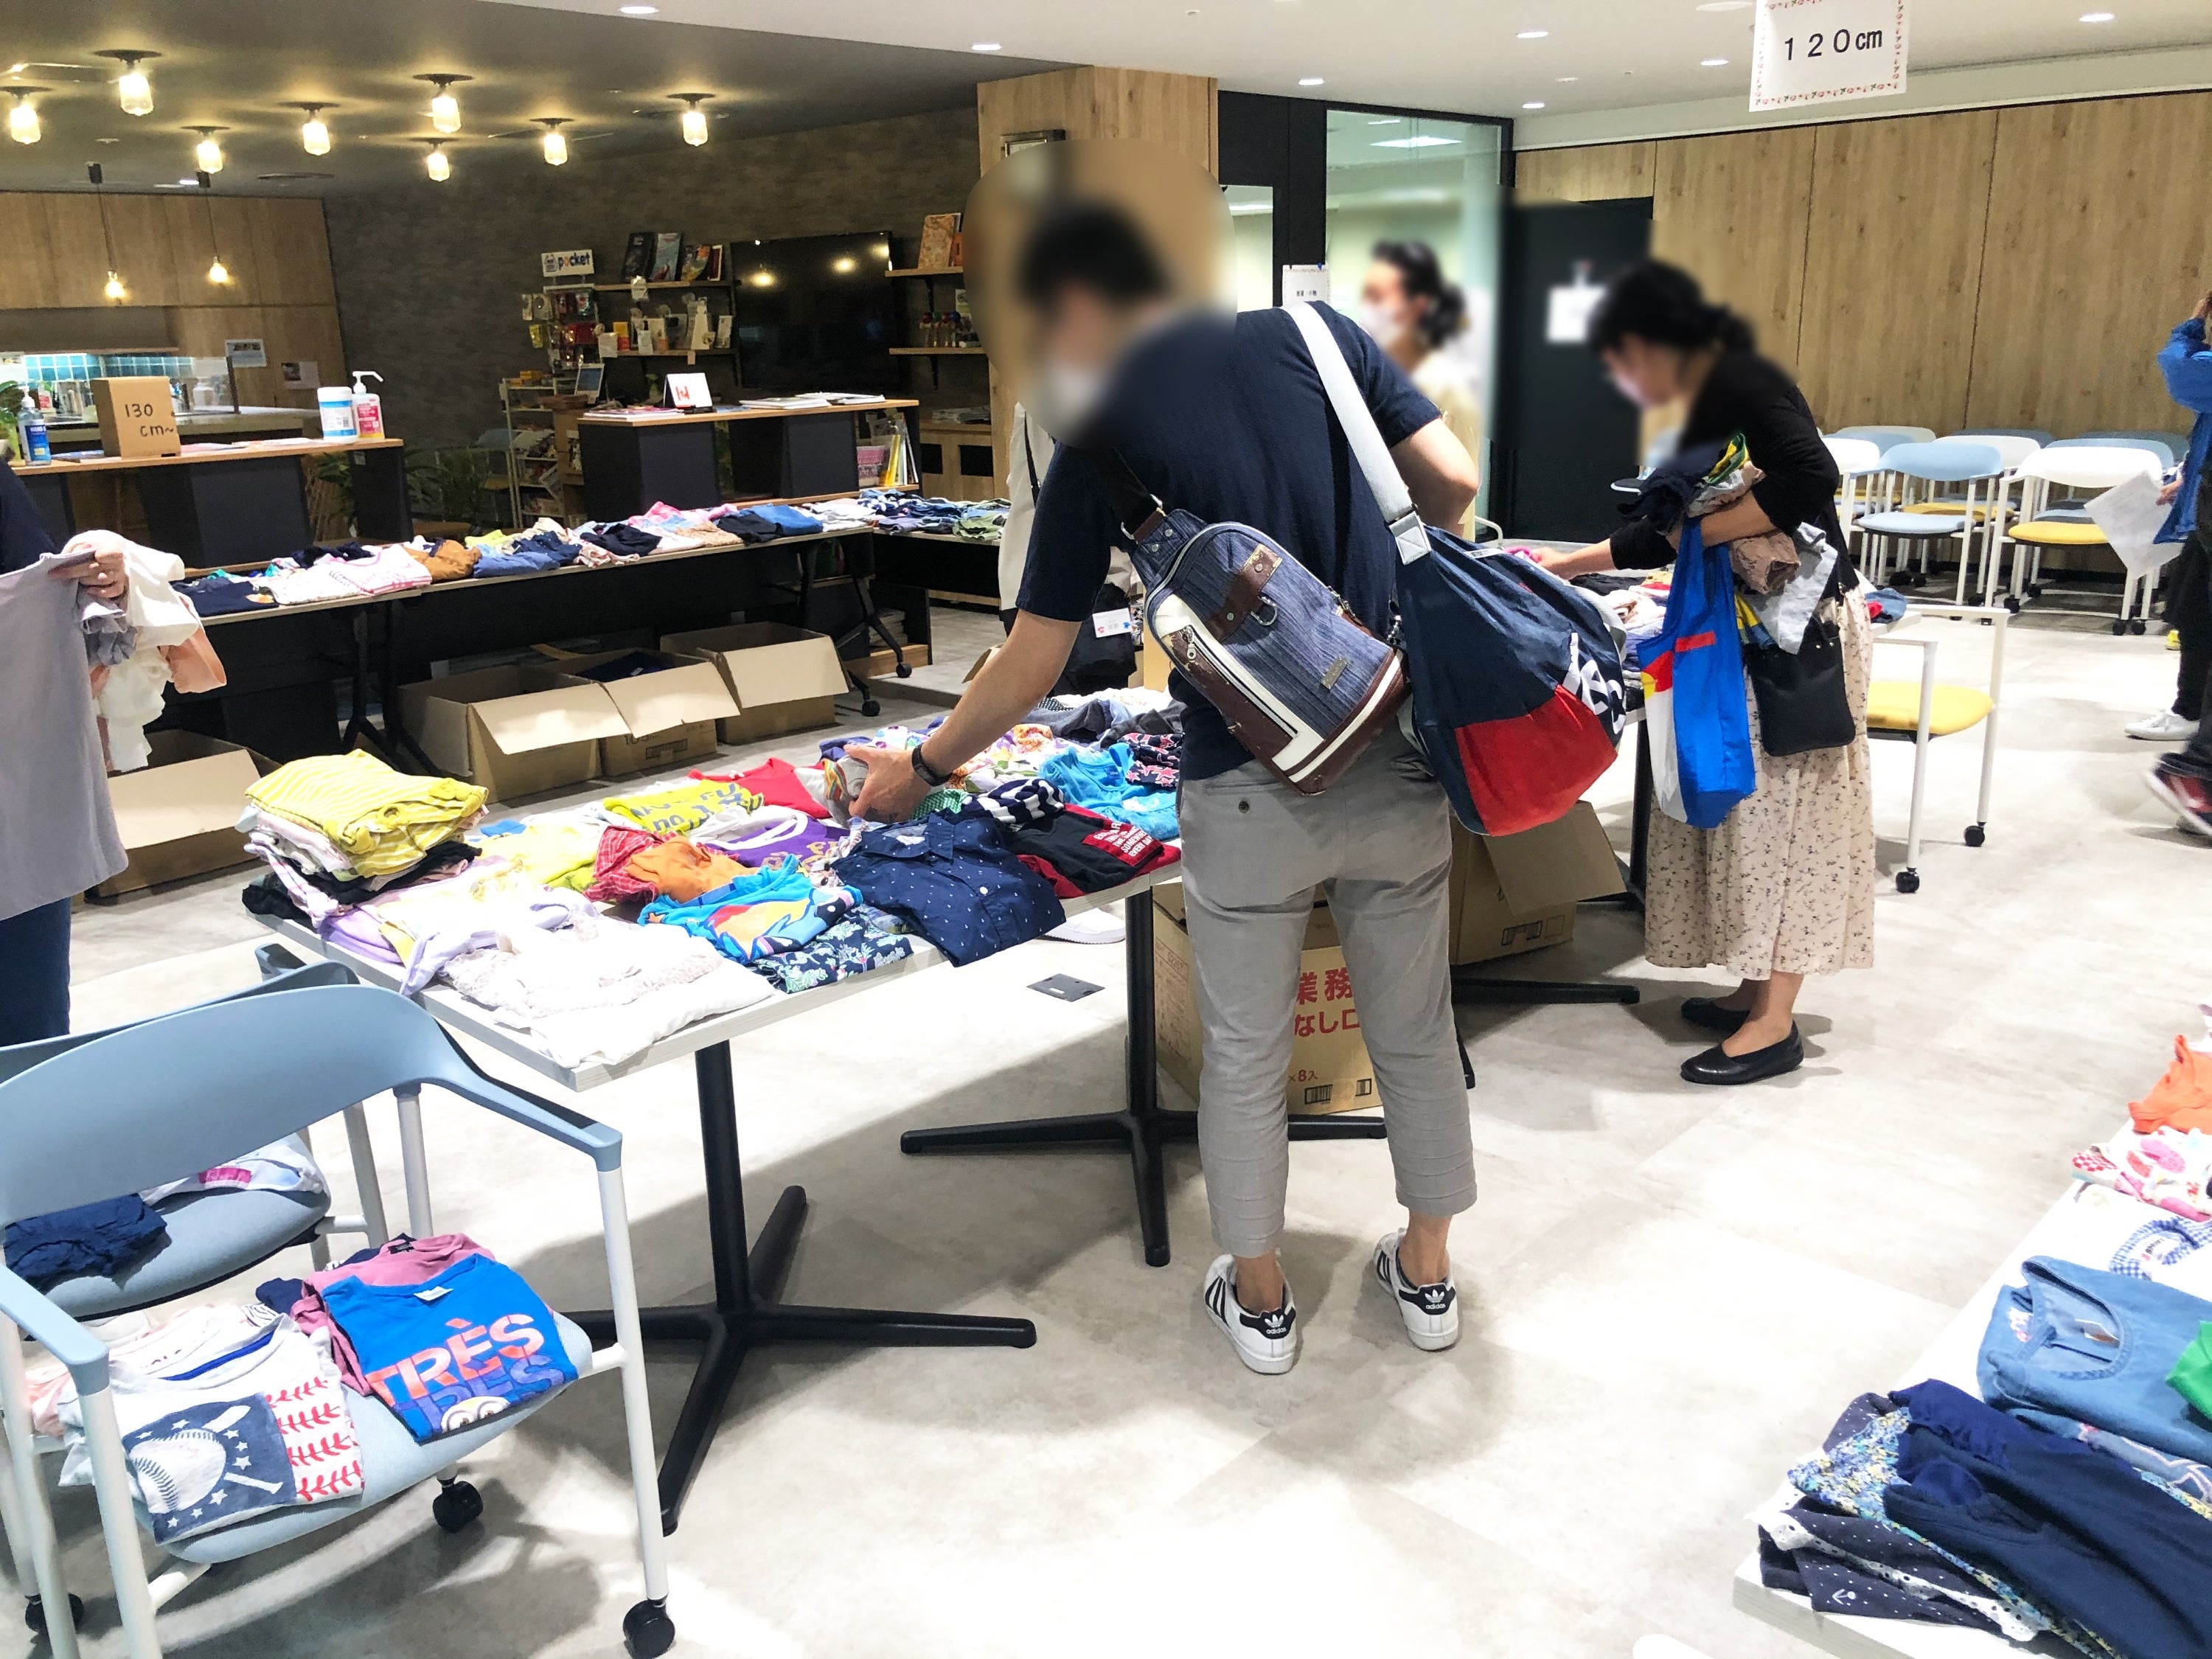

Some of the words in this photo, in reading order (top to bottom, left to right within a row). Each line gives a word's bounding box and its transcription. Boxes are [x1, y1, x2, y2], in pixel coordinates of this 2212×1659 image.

[1784, 29, 1882, 60] 120cm
[557, 252, 590, 271] pocket
[125, 403, 153, 417] 130
[1296, 967, 1353, 1005] 業務
[1266, 1326, 1287, 1335] adidas
[364, 1313, 544, 1408] TRÈS
